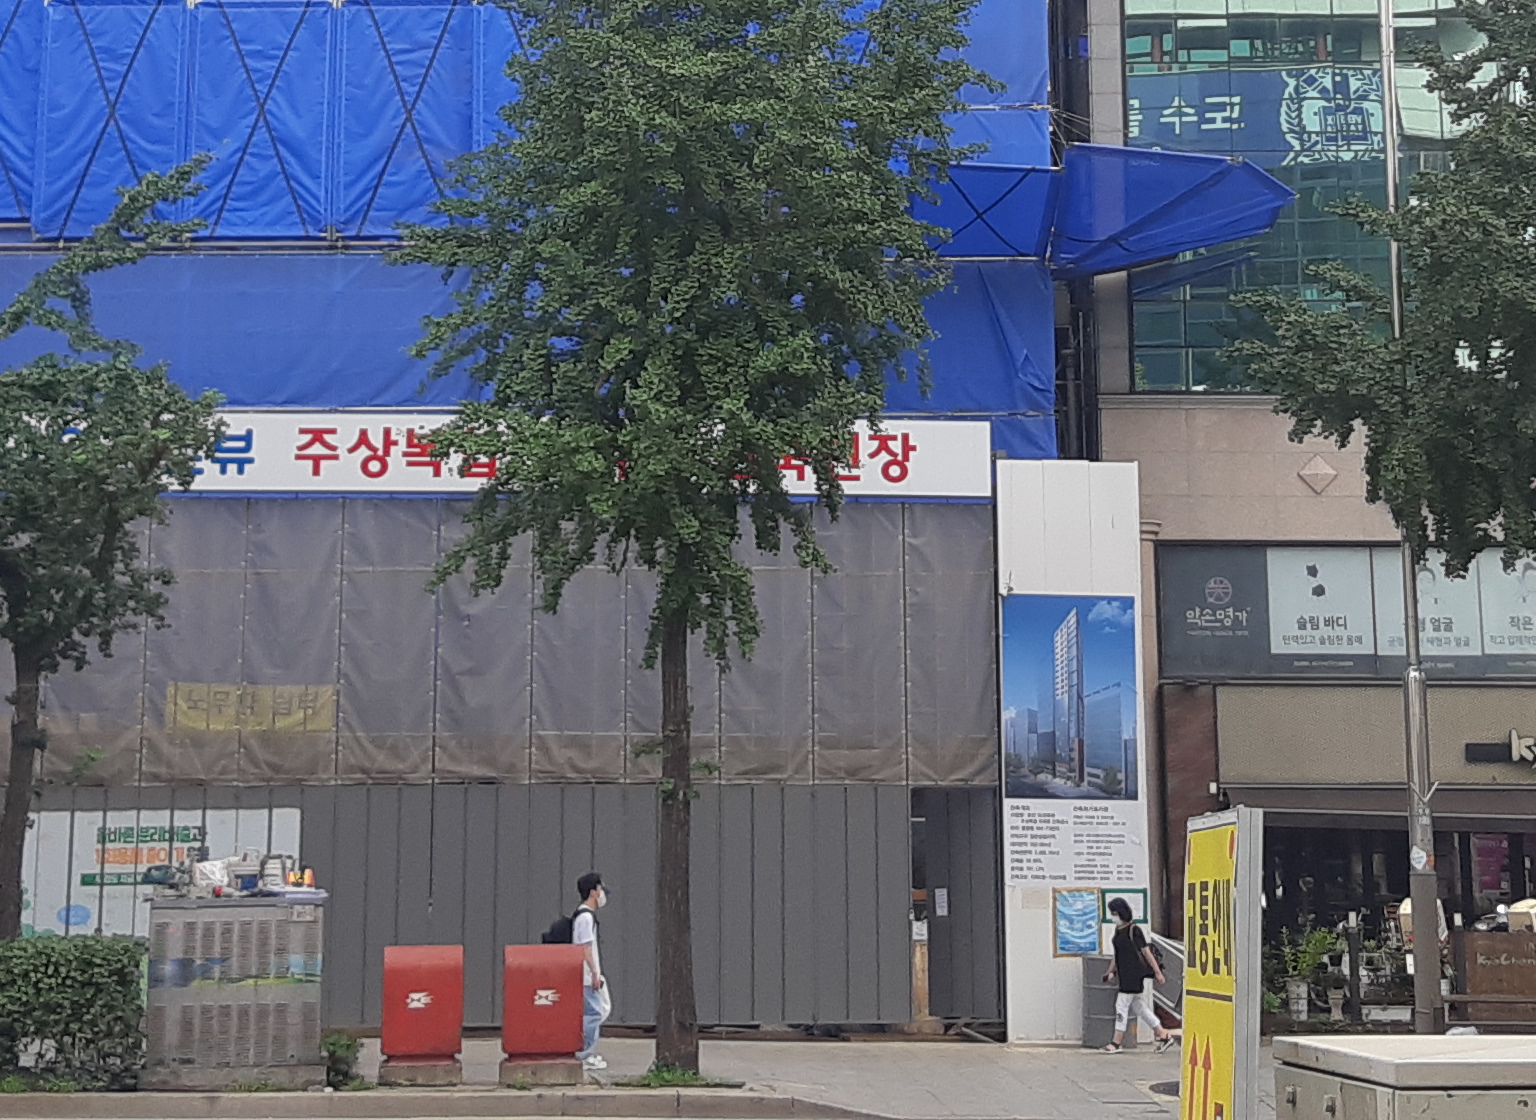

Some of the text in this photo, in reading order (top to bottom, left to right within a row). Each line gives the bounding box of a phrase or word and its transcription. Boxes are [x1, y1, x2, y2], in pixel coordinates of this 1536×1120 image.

[1185, 607, 1249, 627] 약손명가
[1296, 615, 1349, 631] 슬림 바디
[1187, 877, 1232, 977] 교통안내
